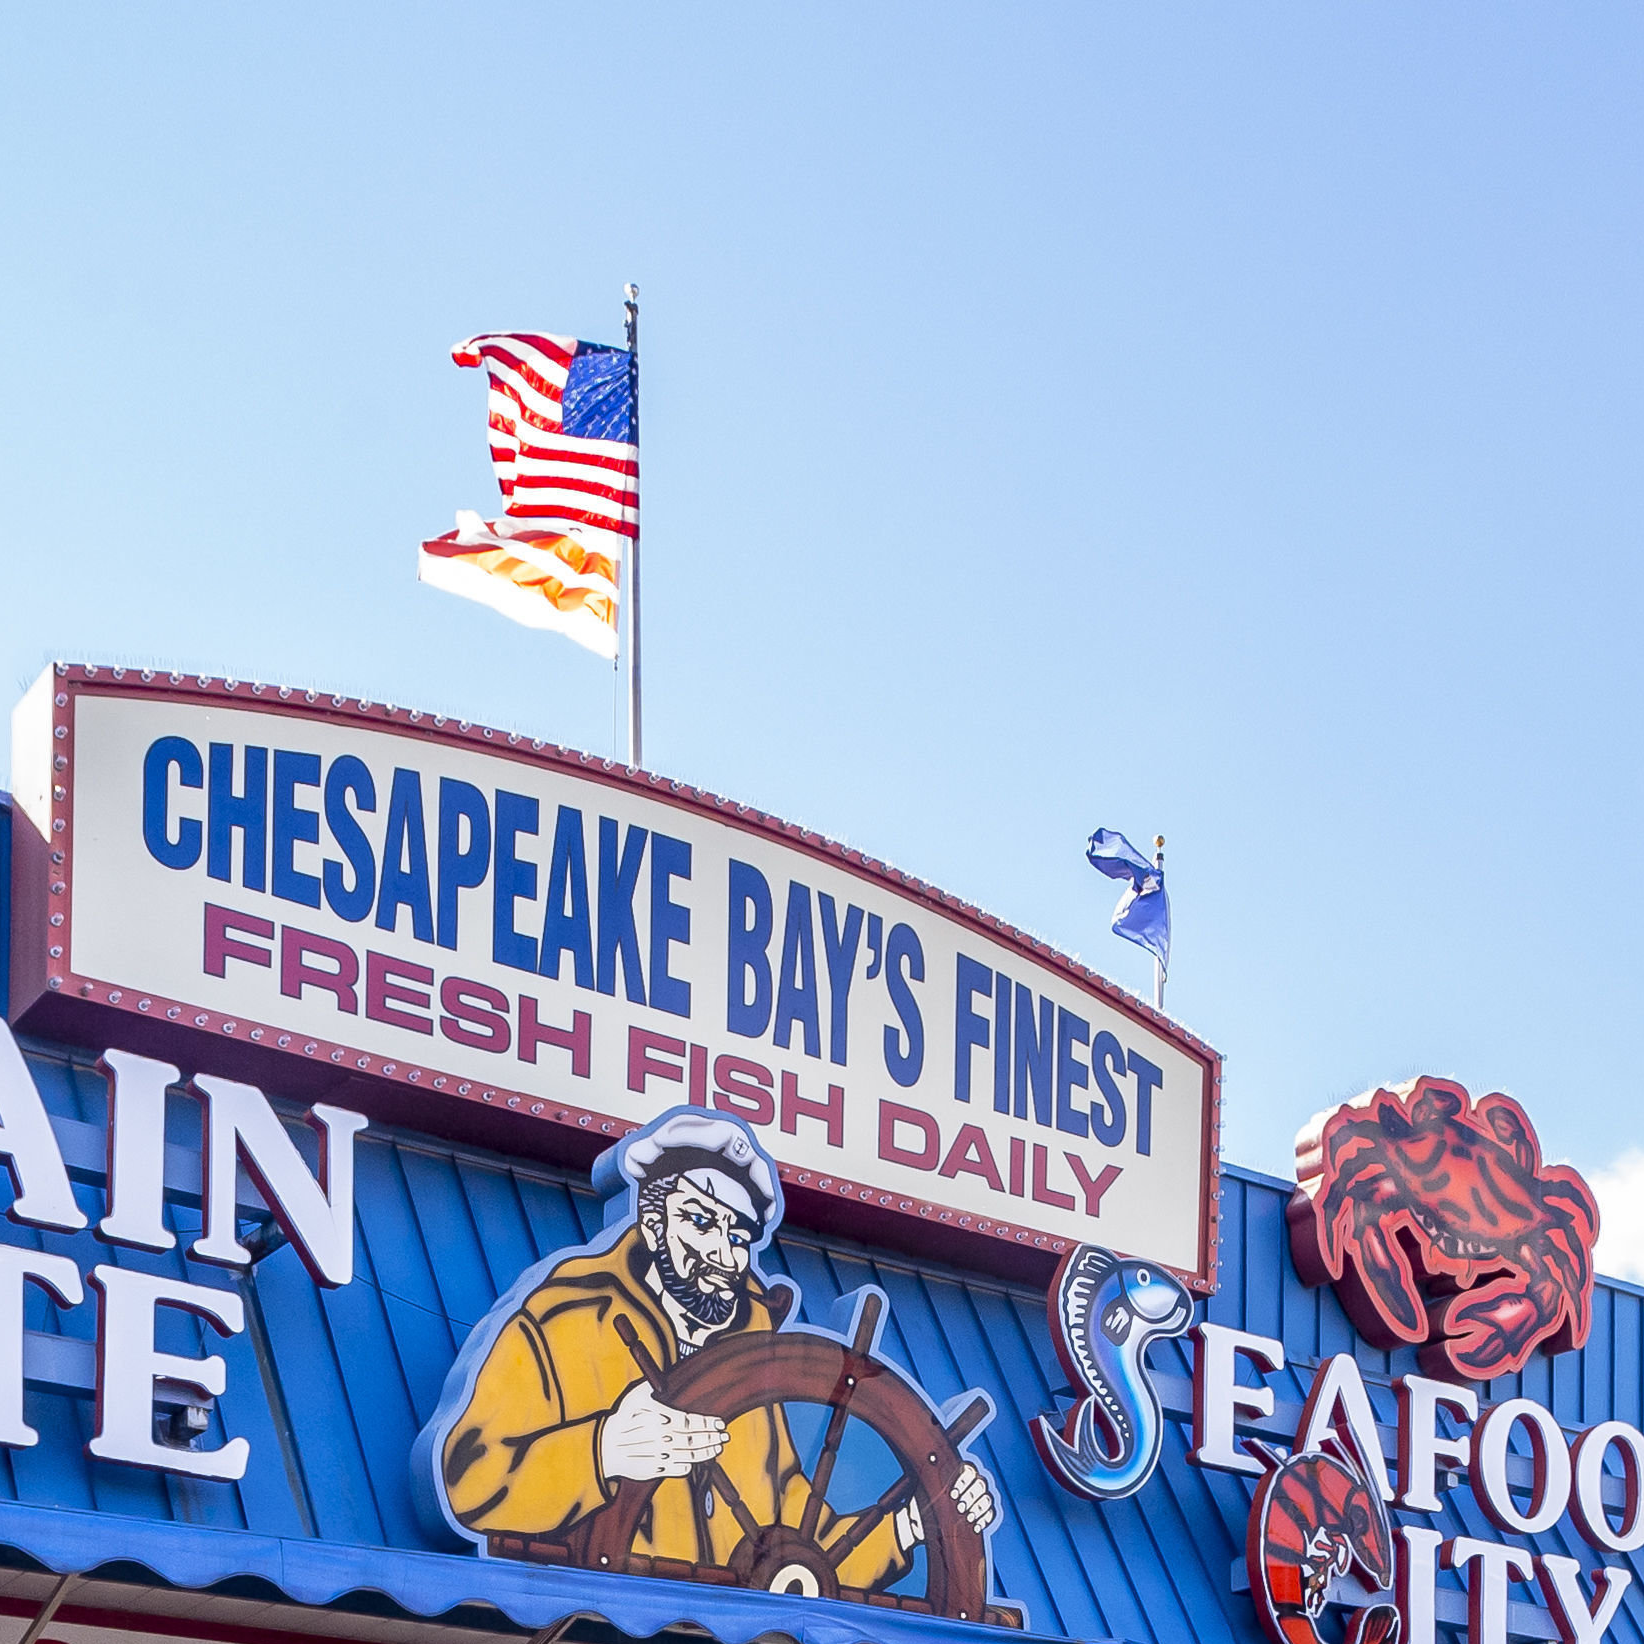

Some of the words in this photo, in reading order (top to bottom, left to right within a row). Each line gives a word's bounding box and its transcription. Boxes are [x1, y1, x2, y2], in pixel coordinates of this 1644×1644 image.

[142, 735, 692, 1019] CHESAPEAKE
[727, 860, 927, 1088] BAY'S
[955, 950, 1164, 1157] FINEST
[203, 903, 592, 1079] FRESH
[628, 1026, 845, 1150] FISH
[877, 1101, 1123, 1218] DAILY
